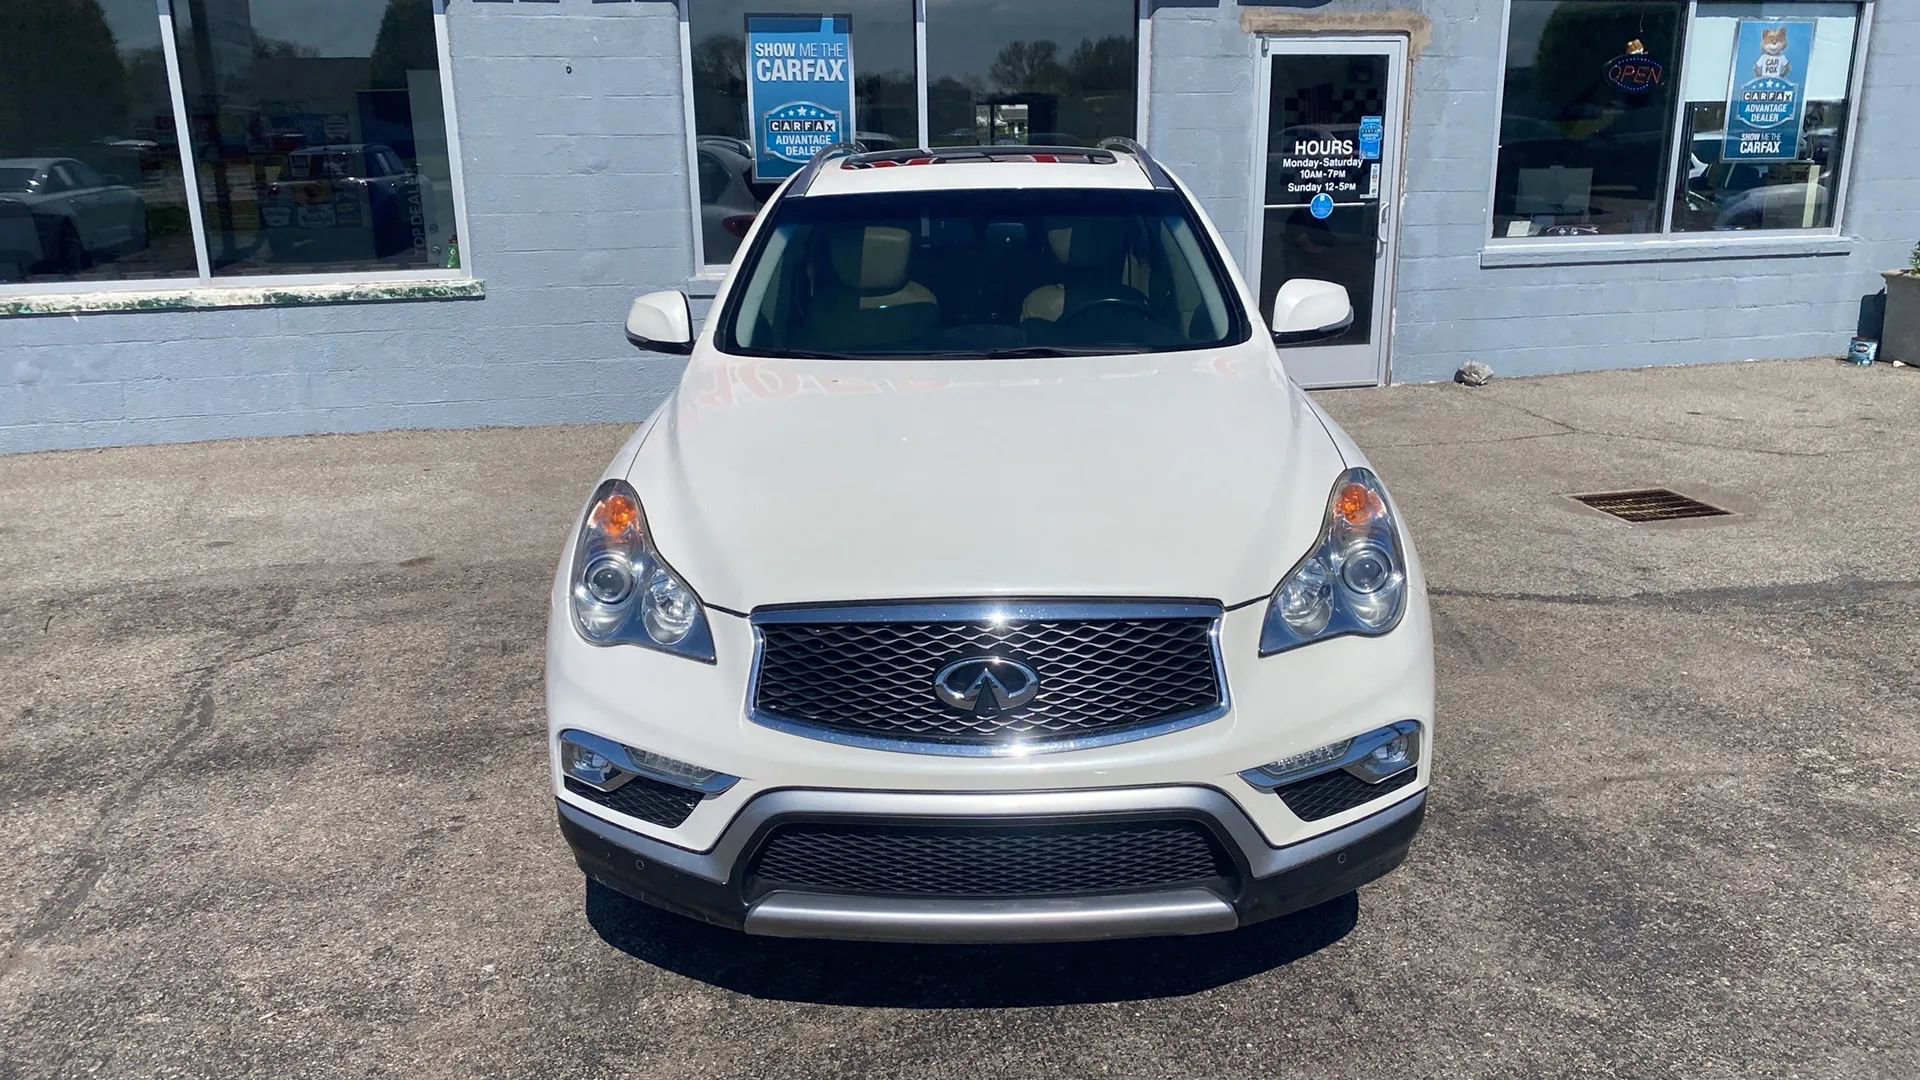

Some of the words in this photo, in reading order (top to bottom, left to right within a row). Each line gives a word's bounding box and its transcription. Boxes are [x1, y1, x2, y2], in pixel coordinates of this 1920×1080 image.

[755, 43, 795, 57] SHOW
[800, 43, 819, 57] ME
[821, 43, 844, 57] THE
[757, 59, 845, 82] CARFAX
[1608, 65, 1663, 85] OPEN
[1744, 92, 1793, 101] CARFAX
[1744, 104, 1787, 112] ADVANTAGE
[1751, 114, 1779, 122] DEALER
[771, 121, 835, 132] CARFAX
[776, 134, 832, 145] ADVANTAGE
[1741, 133, 1761, 141] SHOW
[1294, 140, 1353, 155] HOURS
[1740, 141, 1781, 153] CARFAX
[1287, 182, 1322, 193] Sunday
[1324, 182, 1357, 191] 12-5PM
